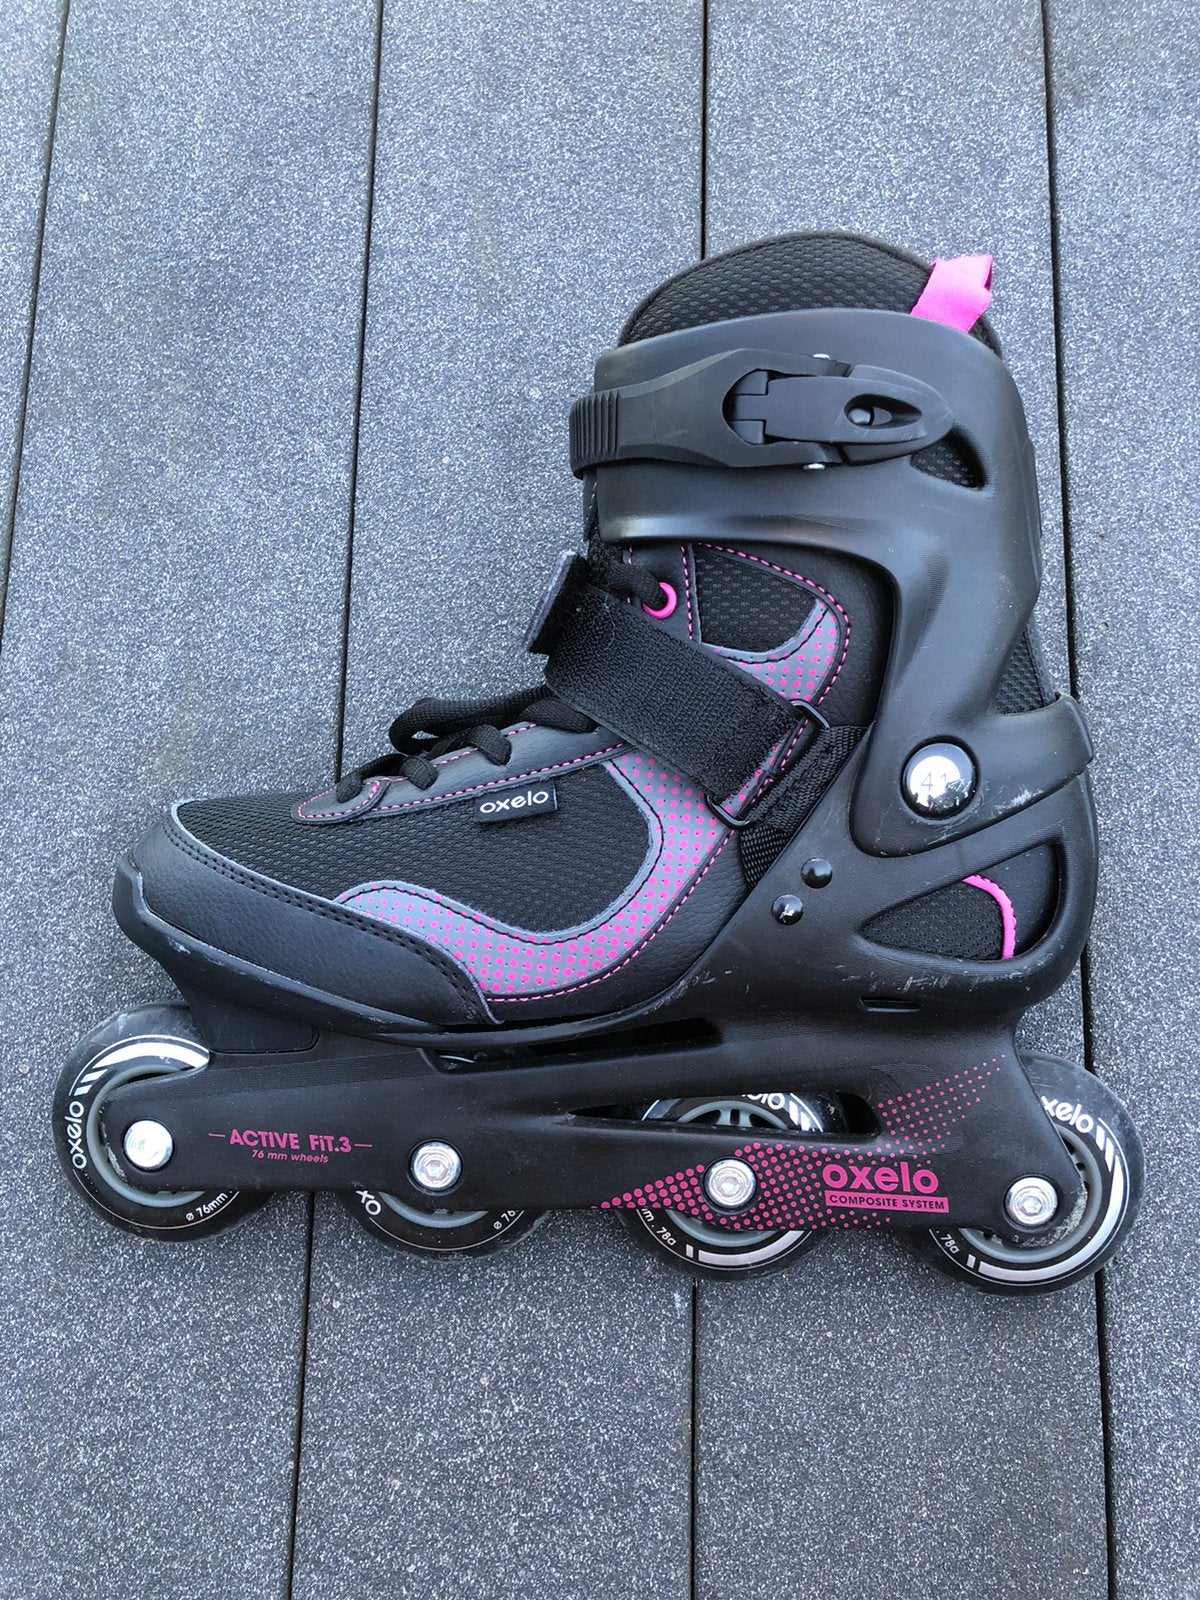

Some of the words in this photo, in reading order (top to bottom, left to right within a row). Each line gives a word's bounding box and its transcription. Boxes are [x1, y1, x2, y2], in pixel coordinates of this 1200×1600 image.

[479, 790, 549, 814] oxelo
[1040, 1095, 1094, 1134] xelo
[64, 1100, 88, 1169] oxelo
[229, 1128, 300, 1150] ACTIVE
[251, 1150, 265, 1159] 76
[267, 1152, 288, 1161] mm
[290, 1153, 329, 1164] wheels
[822, 1161, 939, 1194] oxelo
[195, 1192, 229, 1217] 76mm
[829, 1194, 898, 1207] COMPOSITE
[902, 1199, 945, 1210] SYSTEM
[501, 1209, 516, 1223] 76
